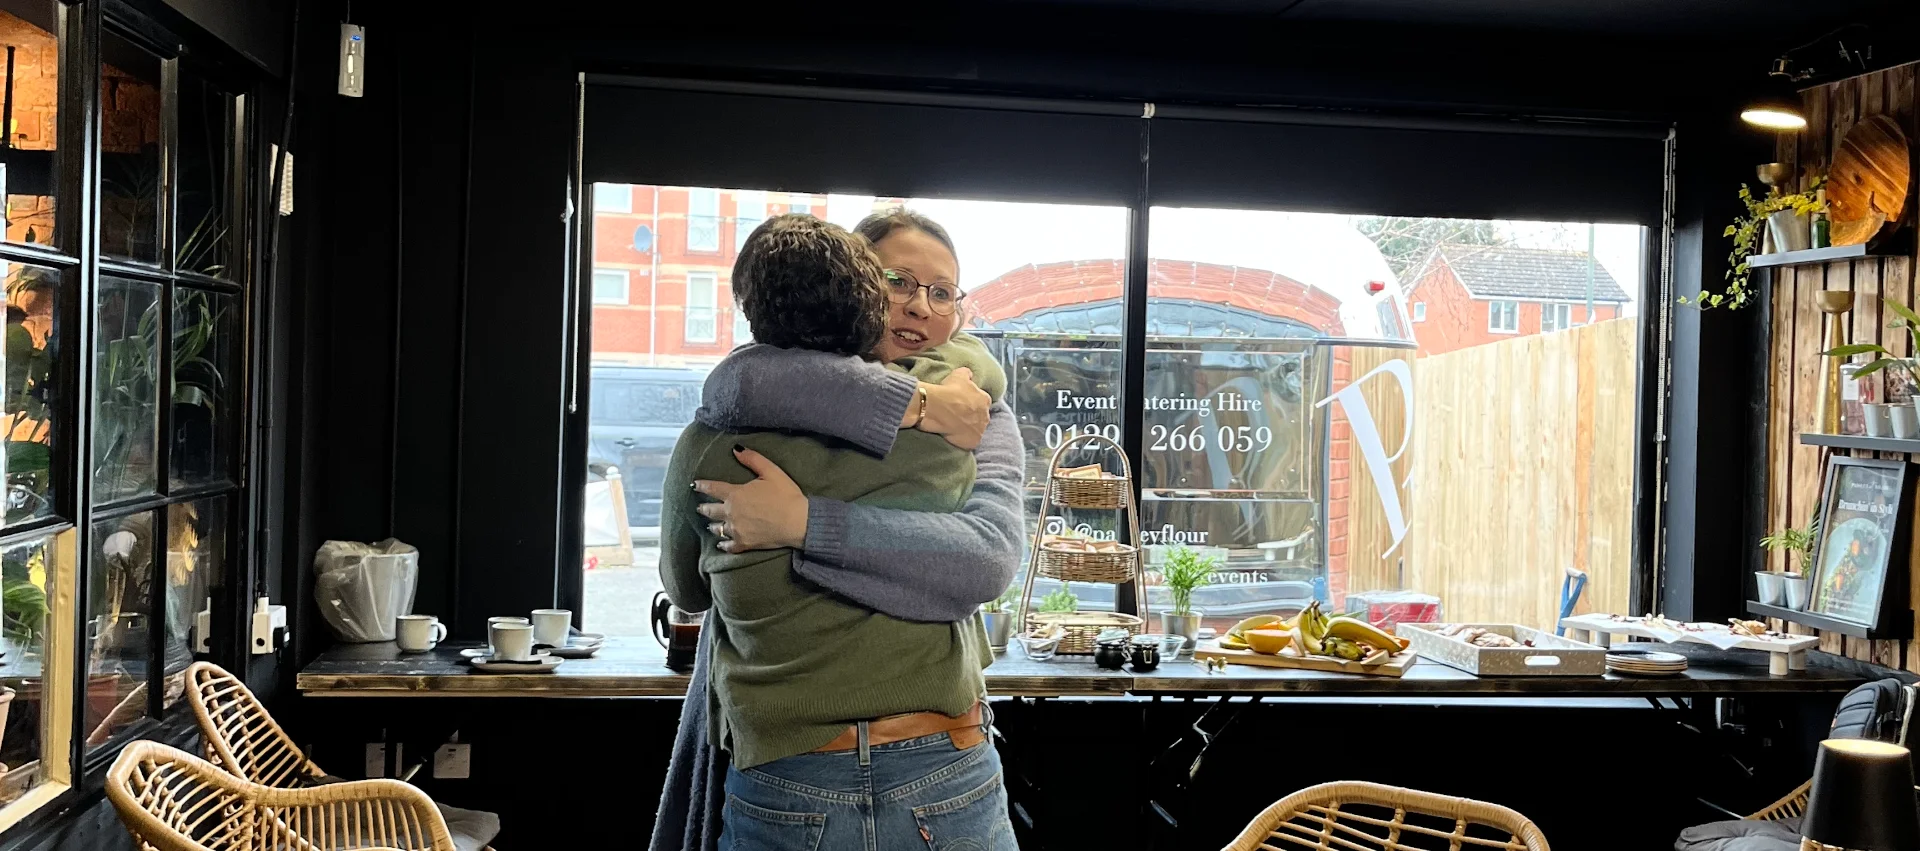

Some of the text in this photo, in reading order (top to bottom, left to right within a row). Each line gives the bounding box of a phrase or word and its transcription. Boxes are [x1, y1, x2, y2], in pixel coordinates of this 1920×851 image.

[1056, 389, 1262, 417] Event atering Hire
[1045, 423, 1273, 453] 0129 266 059
[1207, 570, 1268, 584] events
